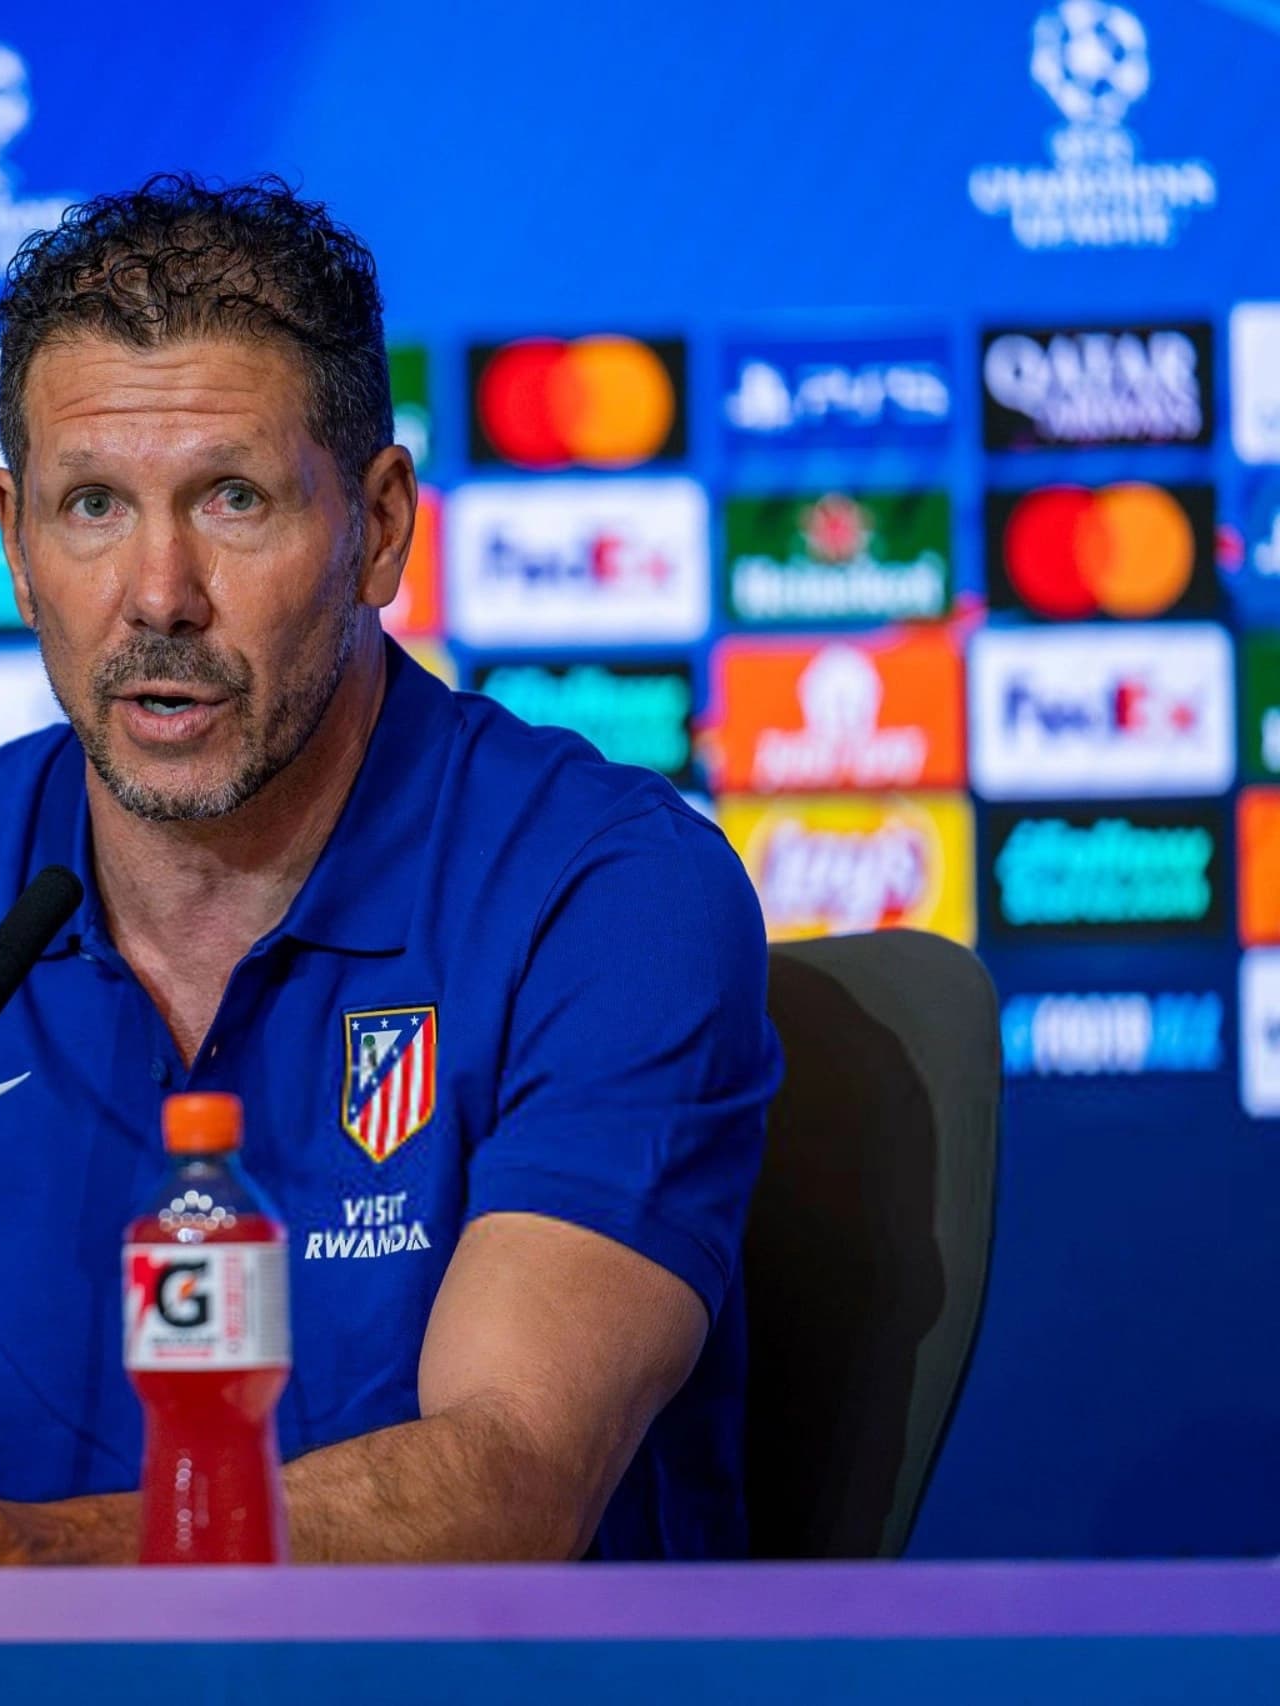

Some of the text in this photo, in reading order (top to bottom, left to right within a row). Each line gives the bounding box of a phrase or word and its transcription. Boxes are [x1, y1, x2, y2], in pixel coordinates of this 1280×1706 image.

[343, 1192, 407, 1227] VISIT
[304, 1220, 432, 1260] RWANDA
[156, 1260, 209, 1329] G
